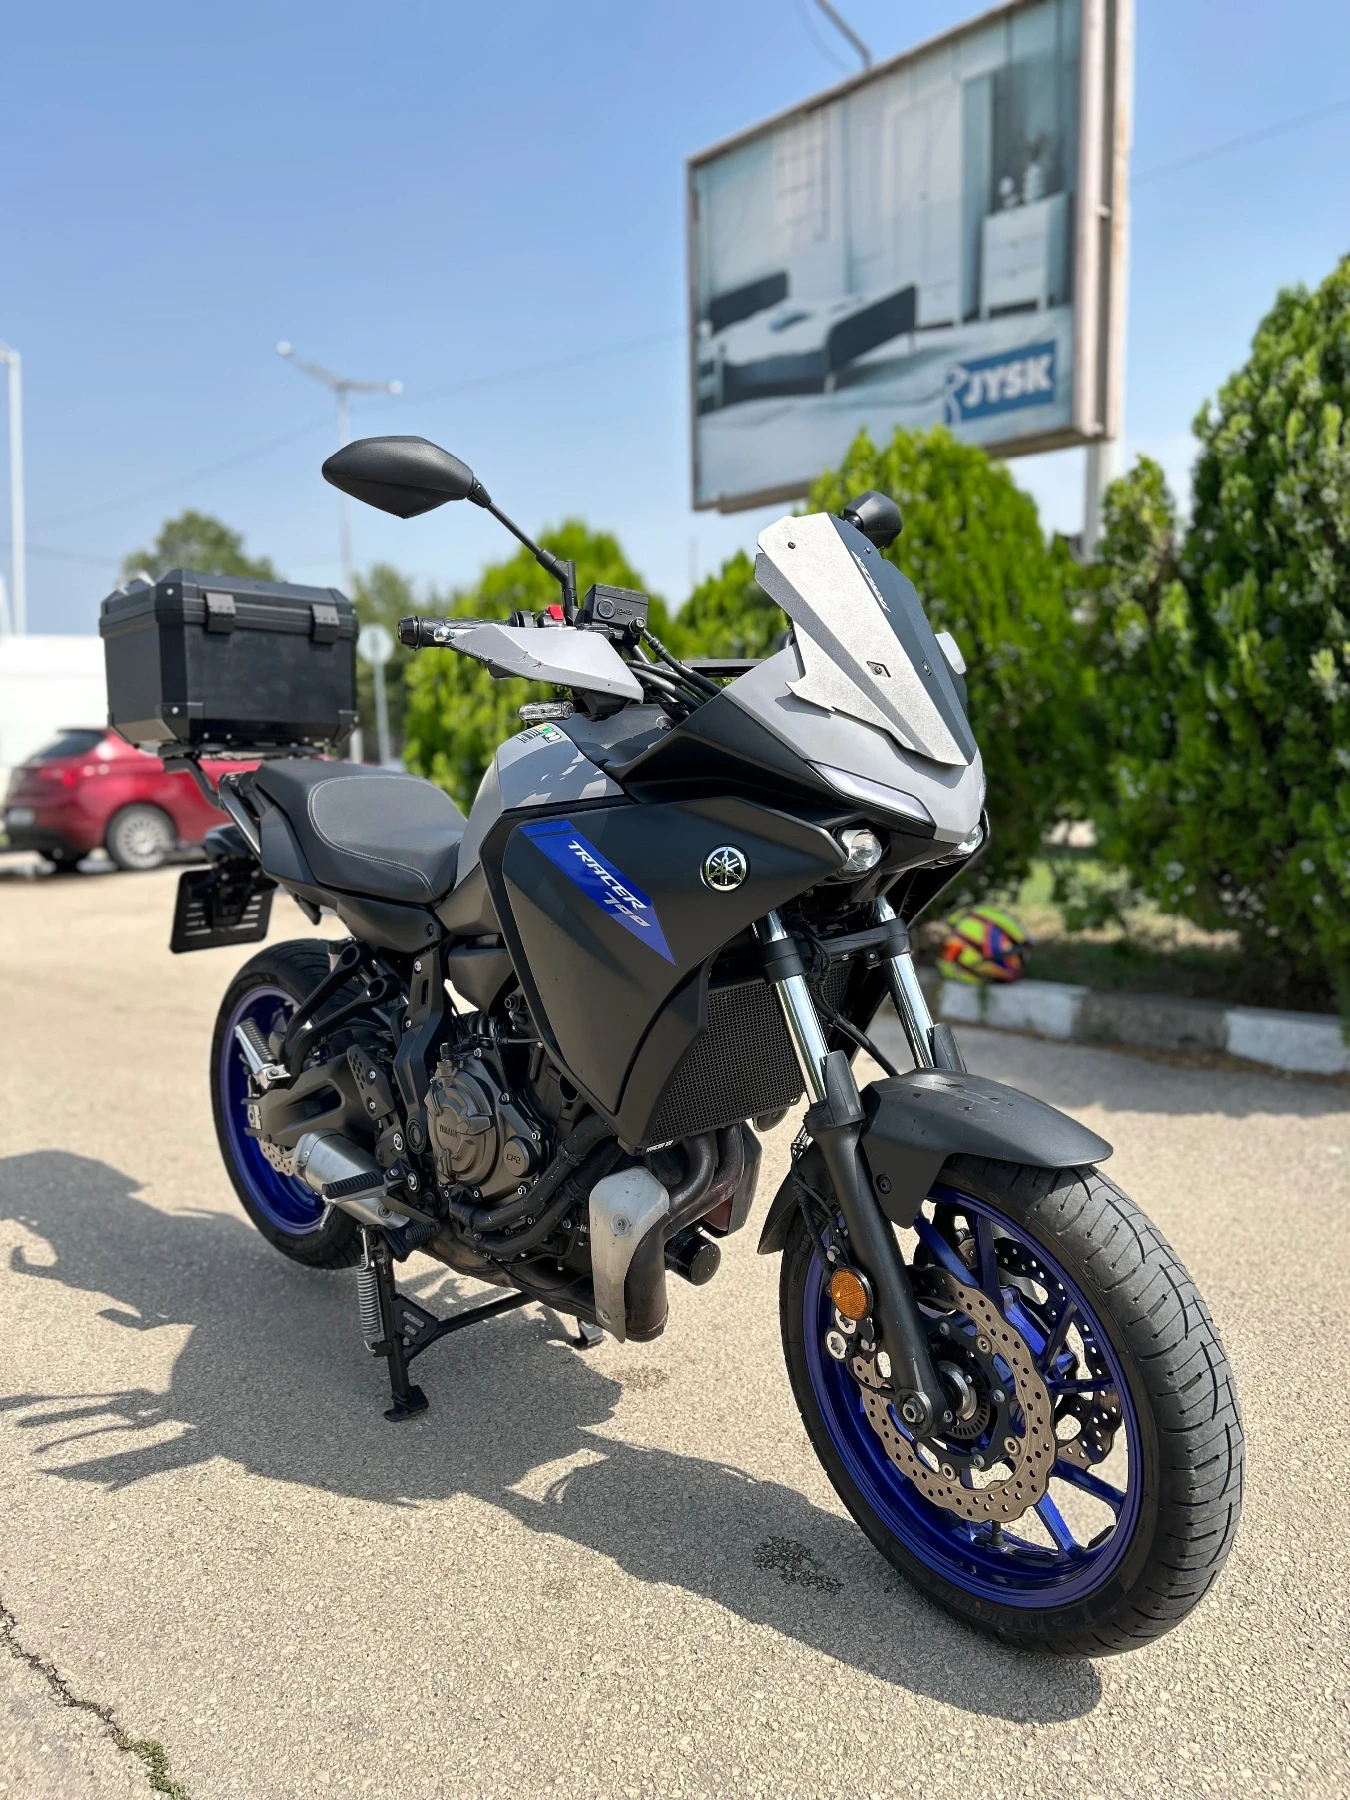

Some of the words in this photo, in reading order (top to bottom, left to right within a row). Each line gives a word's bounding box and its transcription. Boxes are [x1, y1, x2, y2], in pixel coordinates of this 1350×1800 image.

[963, 353, 1052, 408] JYSK
[568, 840, 647, 911] TRACER
[603, 891, 651, 927] 700
